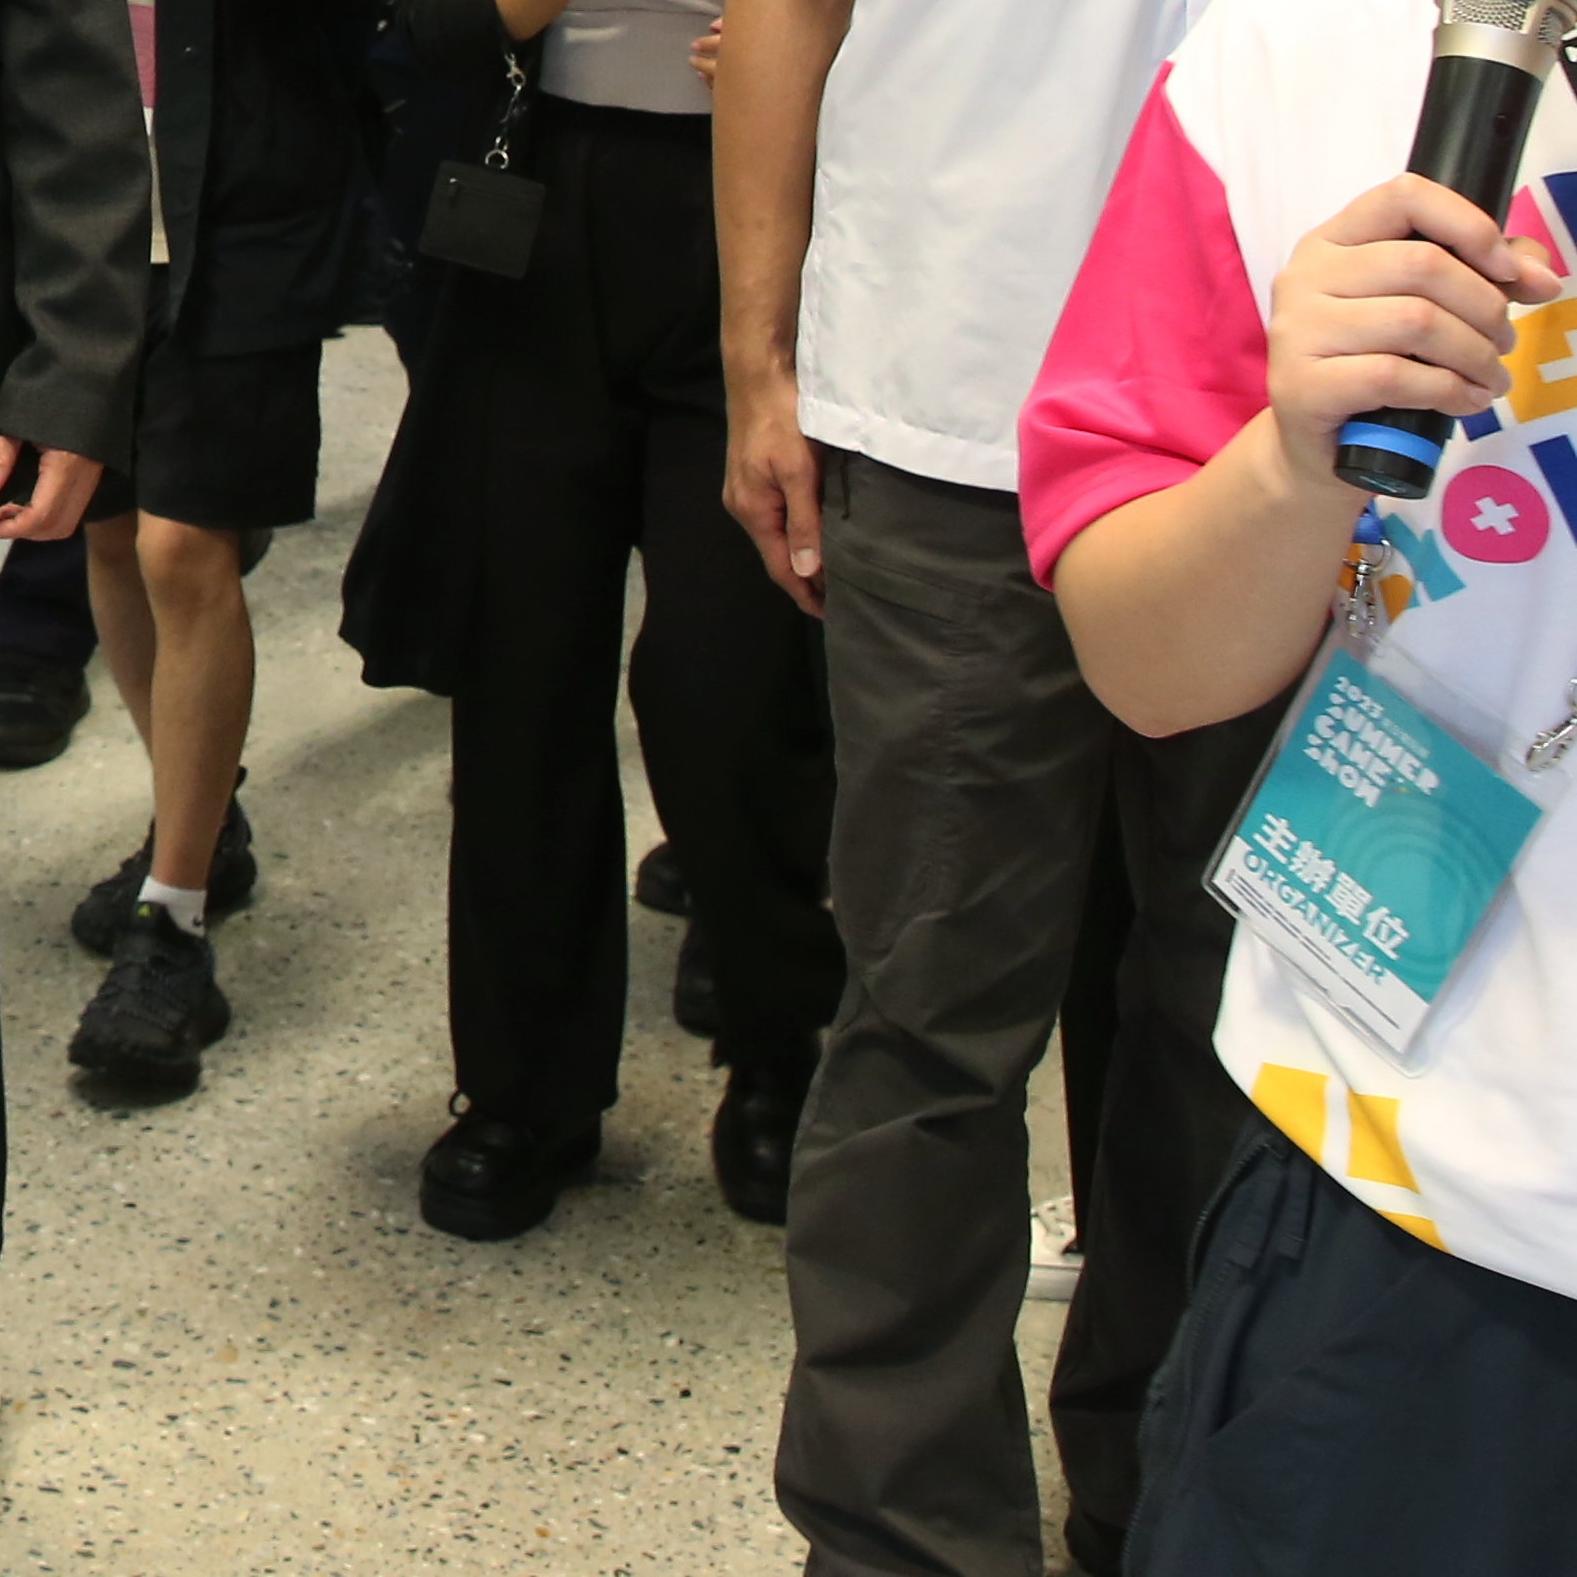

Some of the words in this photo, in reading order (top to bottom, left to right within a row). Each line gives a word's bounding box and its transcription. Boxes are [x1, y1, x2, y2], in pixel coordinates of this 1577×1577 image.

[1324, 692, 1441, 797] SUMMER
[1333, 675, 1385, 720] 2023
[1313, 714, 1393, 788] GAME
[1243, 850, 1388, 986] ORGANIZER
[1251, 812, 1411, 961] 主辦單位
